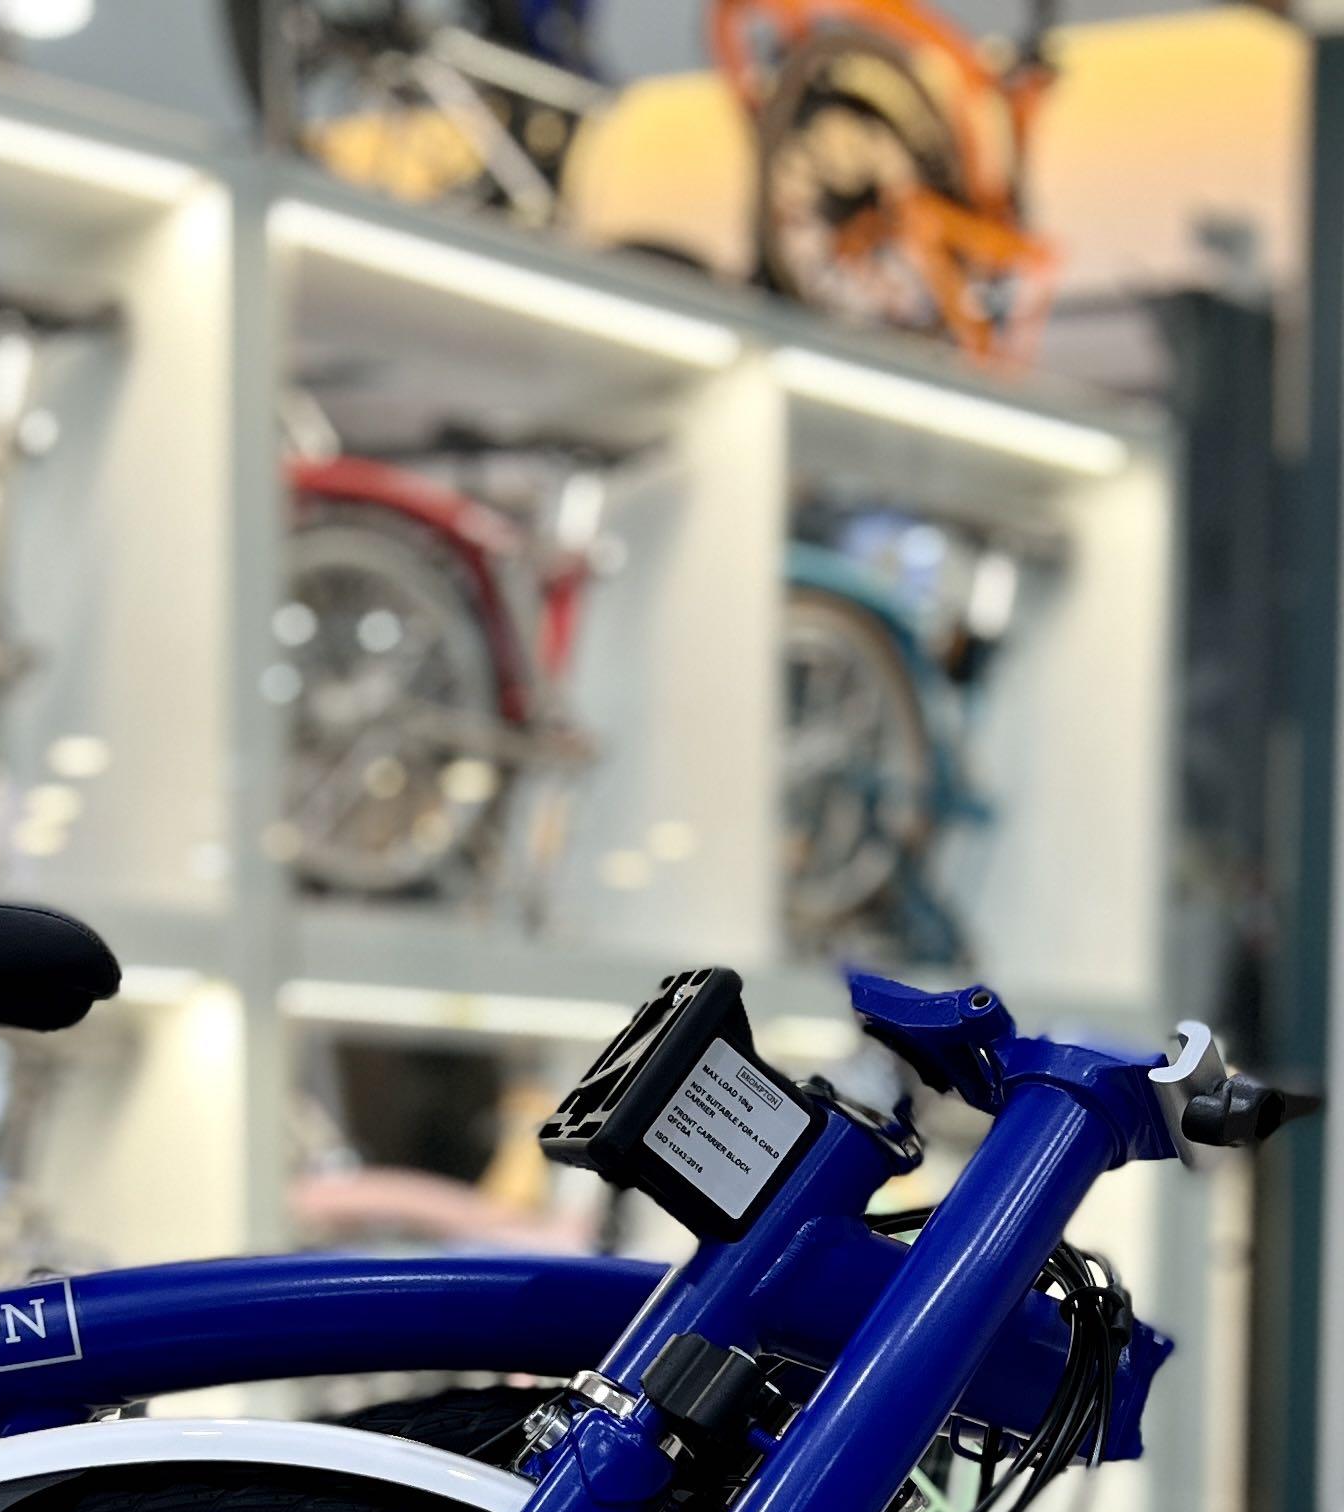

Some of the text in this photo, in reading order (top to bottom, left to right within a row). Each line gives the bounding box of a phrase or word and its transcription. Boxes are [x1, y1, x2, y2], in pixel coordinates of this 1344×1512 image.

[702, 1064, 718, 1082] MAX
[717, 1078, 737, 1098] LOAD
[740, 1070, 778, 1106] BROMPTON
[684, 1089, 716, 1119] CARRIER
[690, 1081, 706, 1096] NOT
[705, 1093, 738, 1126] SUITABLE
[737, 1121, 753, 1137] FOR
[758, 1139, 780, 1160] CHILD
[654, 1130, 667, 1144] ISO
[673, 1105, 752, 1175] FRONT CARRIER BLOCK
